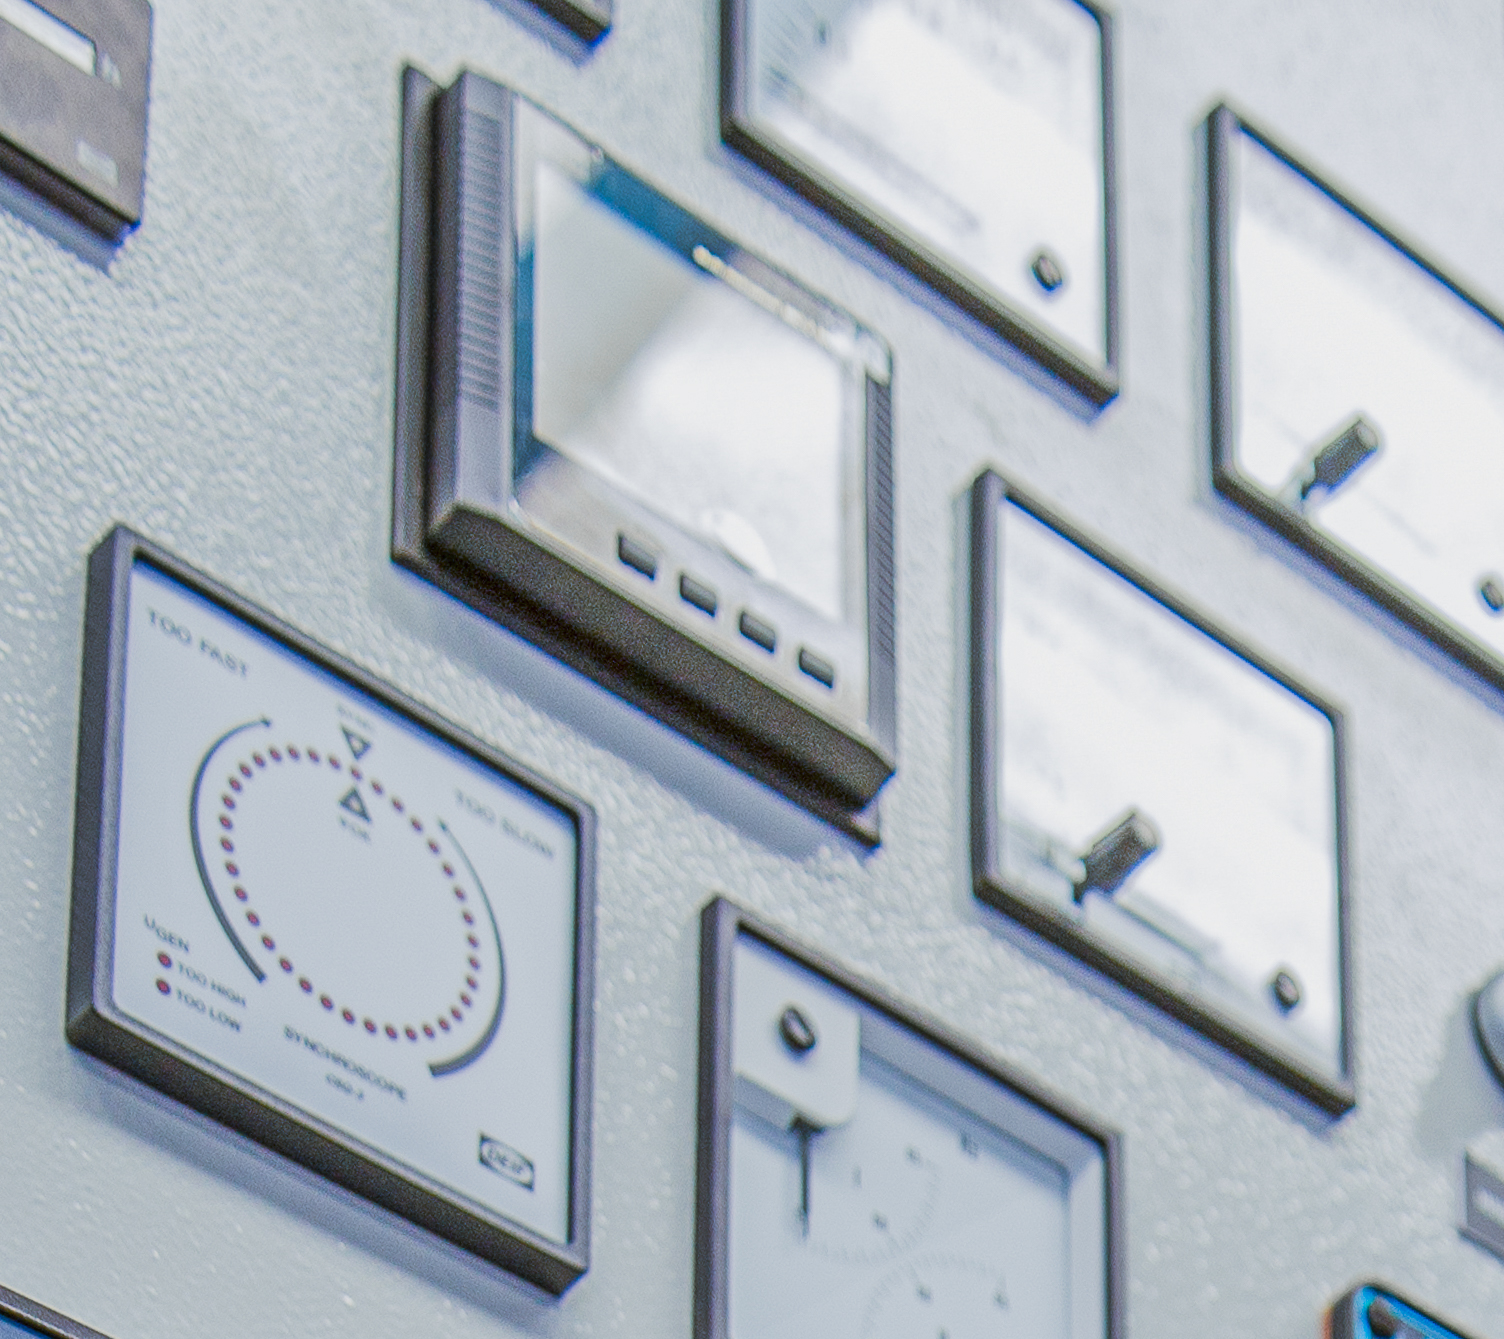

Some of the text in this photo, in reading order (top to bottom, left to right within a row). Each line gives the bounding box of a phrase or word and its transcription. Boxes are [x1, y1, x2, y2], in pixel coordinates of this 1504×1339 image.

[147, 607, 248, 677] TOO FAST
[177, 961, 208, 986] TOO
[175, 987, 241, 1032] TOO LOW
